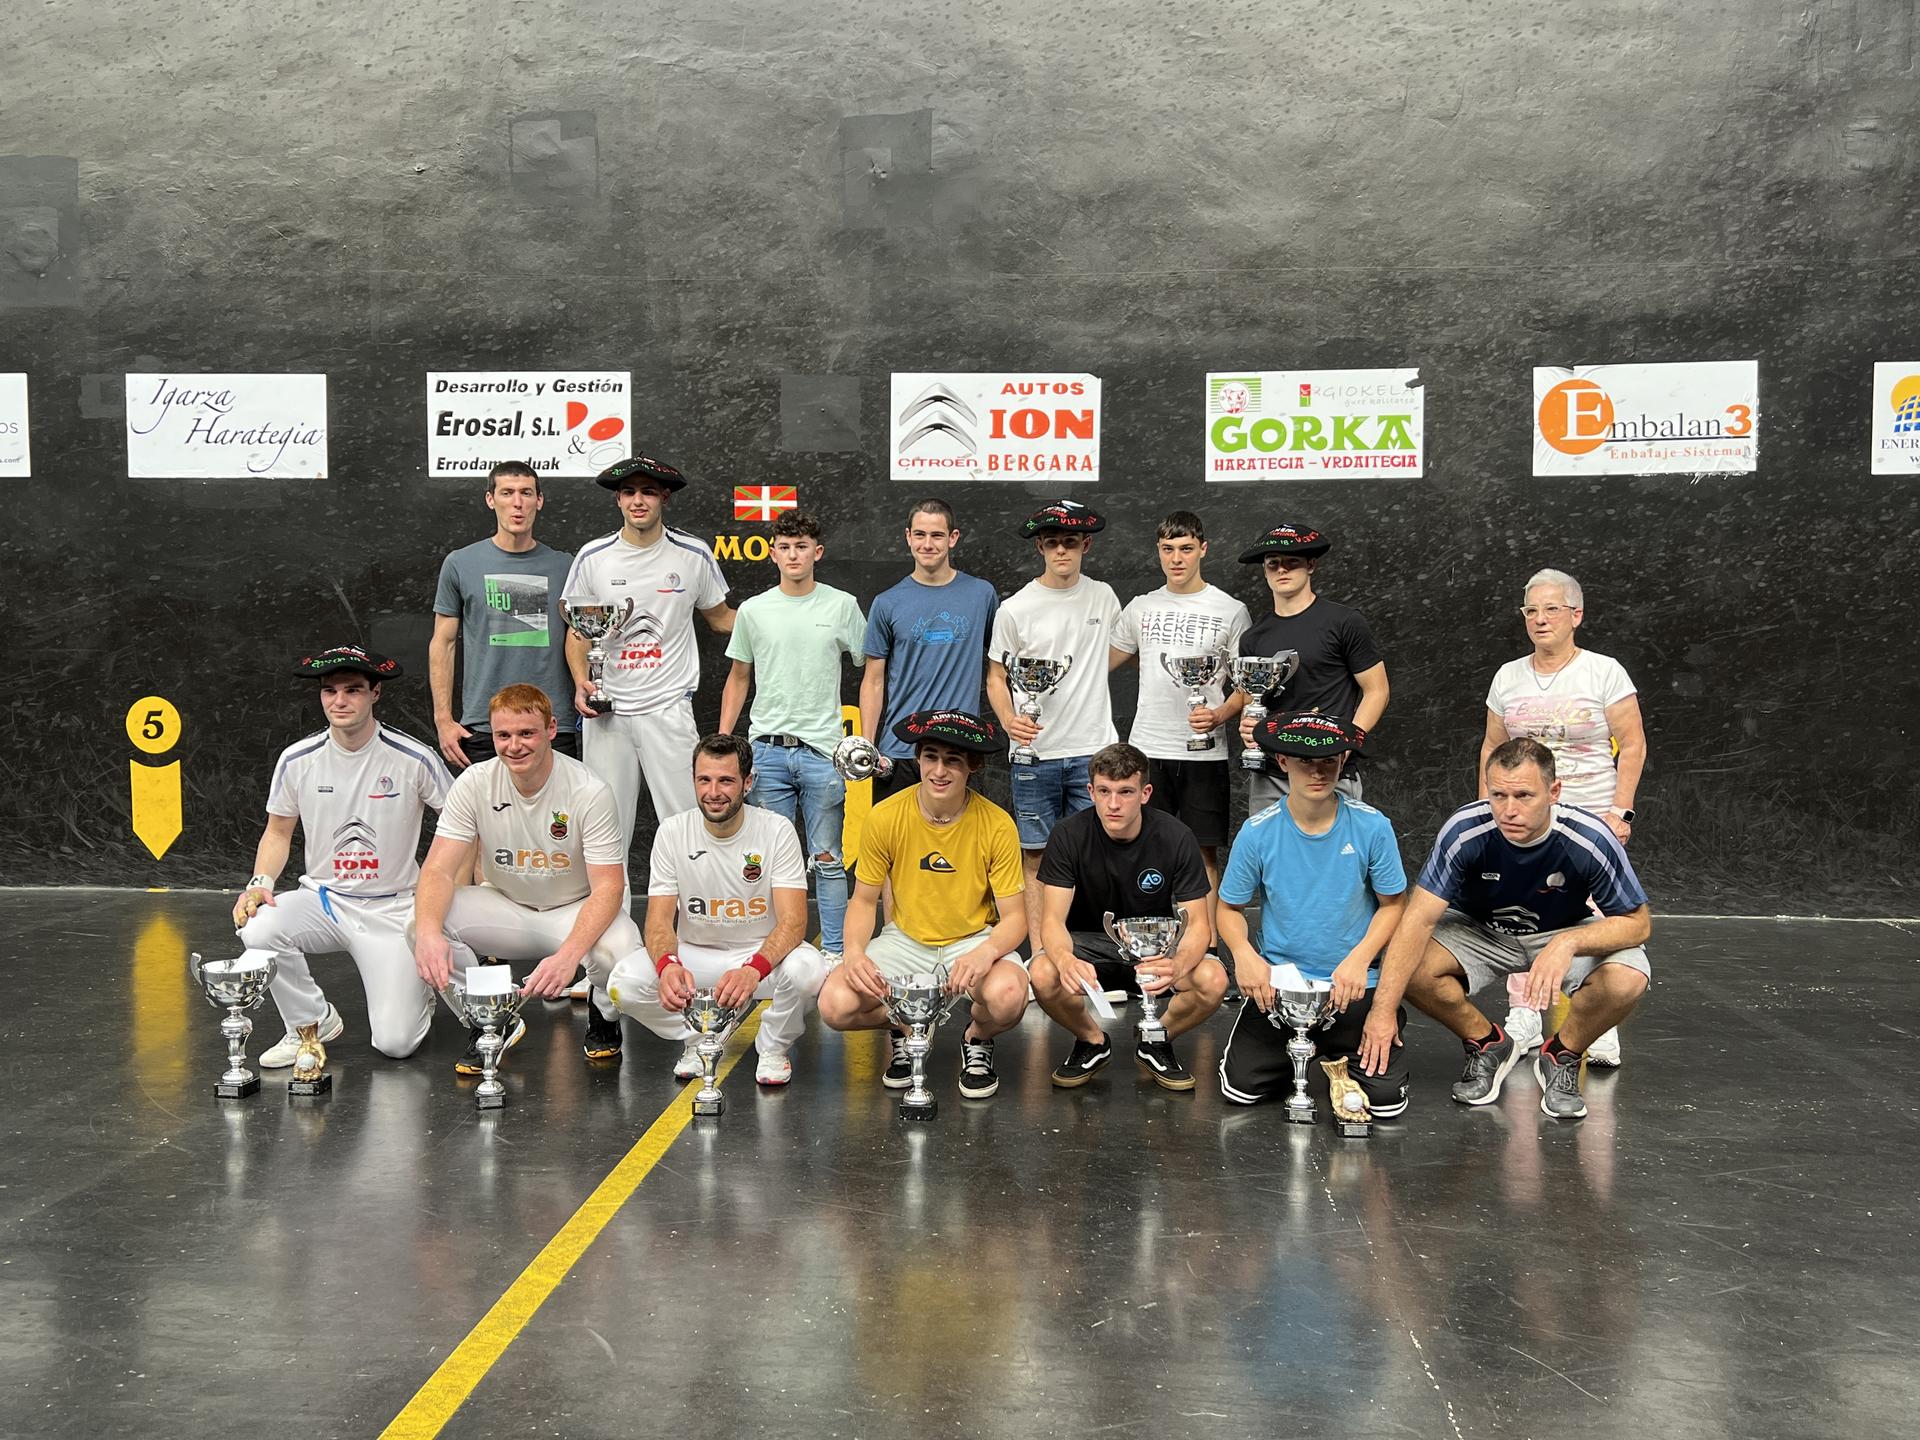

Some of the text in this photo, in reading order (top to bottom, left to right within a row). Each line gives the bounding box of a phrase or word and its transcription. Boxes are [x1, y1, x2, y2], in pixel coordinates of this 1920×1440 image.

[435, 379, 623, 396] Desarrollo y Gestión
[1000, 382, 1085, 396] AUTOS
[131, 378, 236, 434] Igarza
[436, 410, 561, 438] Erosal, S.L.
[989, 408, 1094, 439] ION
[1210, 414, 1417, 453] GORKA
[184, 414, 325, 473] Harategia
[988, 454, 1093, 472] BERGARA
[1214, 456, 1305, 471] HARATEGIA
[1141, 622, 1221, 638] HACKETT
[620, 648, 662, 660] ION
[142, 709, 164, 740] 5
[333, 858, 379, 870] ION
[494, 848, 571, 870] aras
[687, 897, 767, 918] aras
